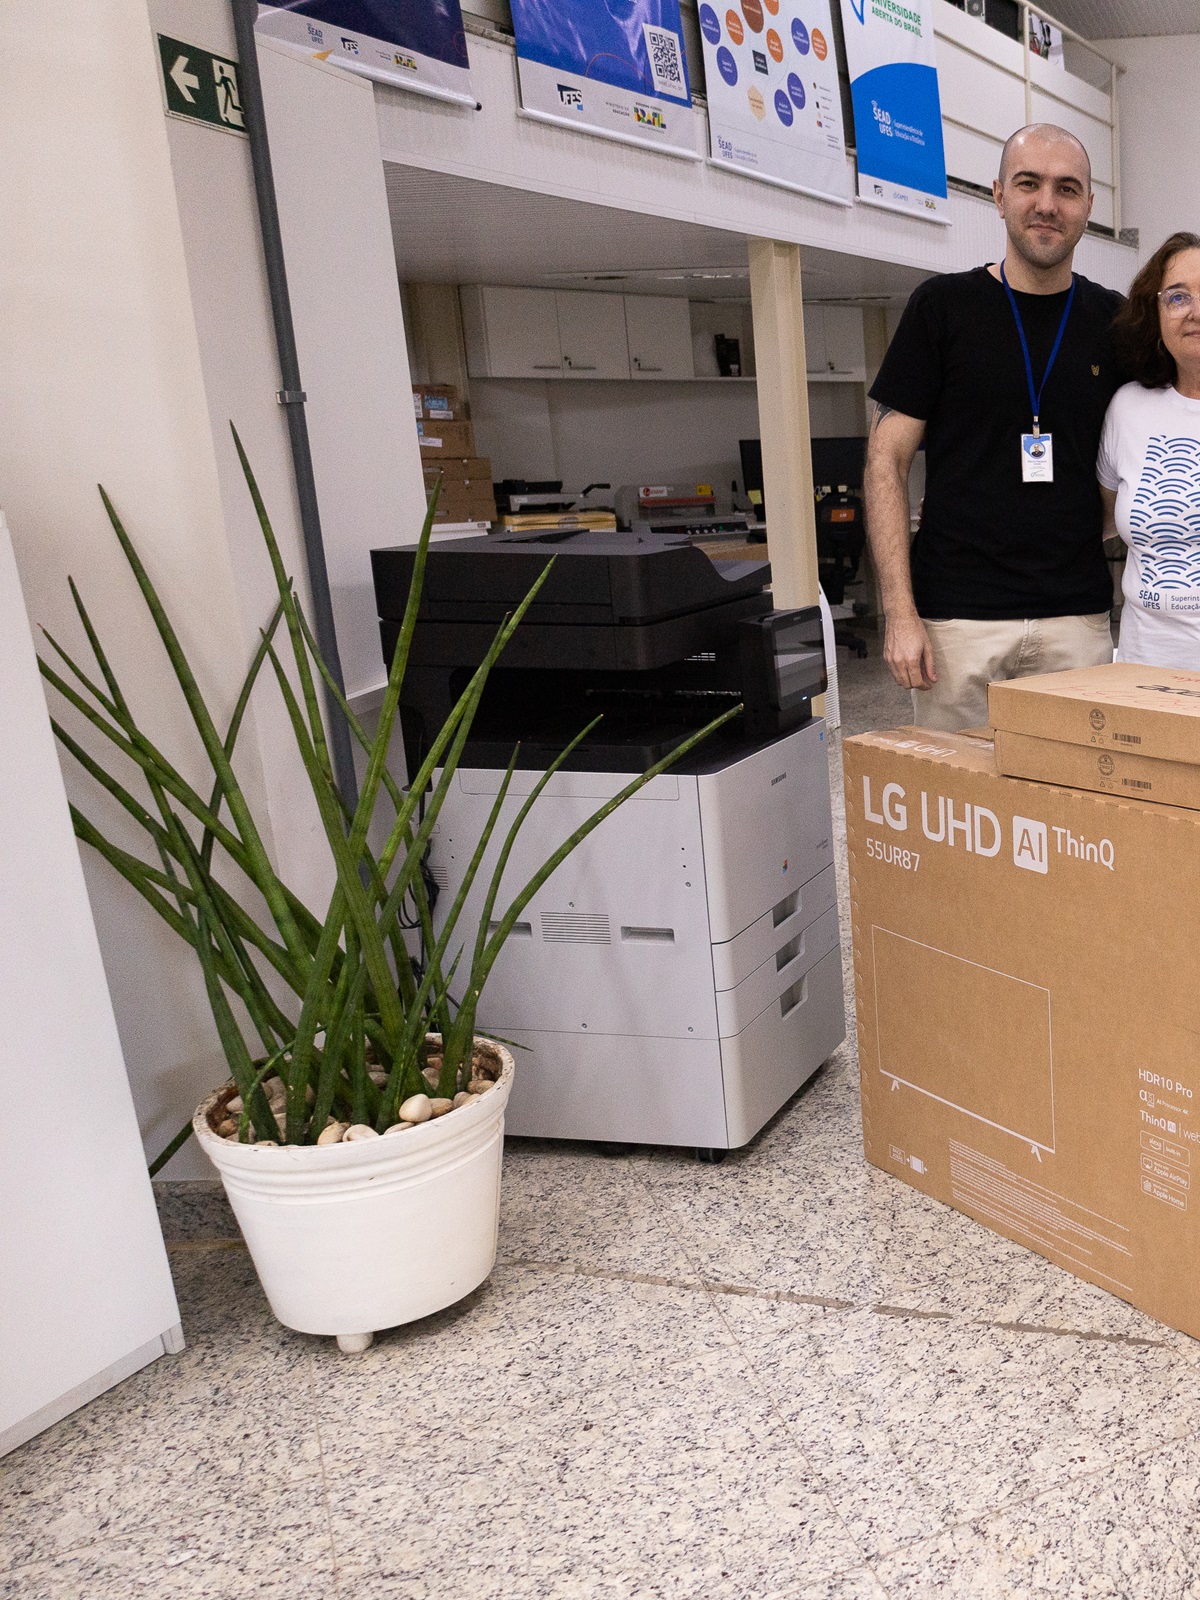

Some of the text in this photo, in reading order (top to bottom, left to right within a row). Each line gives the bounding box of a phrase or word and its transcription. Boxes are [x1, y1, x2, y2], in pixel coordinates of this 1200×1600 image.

[872, 7, 922, 38] ABERTA DO BRASIL
[872, 107, 892, 125] SEAD
[879, 122, 893, 137] UFES
[718, 138, 733, 152] SEAD
[722, 150, 733, 159] UFES
[1138, 589, 1160, 602] SEAD
[1143, 601, 1161, 610] UFES
[770, 772, 787, 786] SAMSUNG
[863, 775, 1115, 871] LG UHD AI ThinQ
[866, 837, 920, 872] 55UR87
[1138, 1067, 1193, 1098] HDR10 Pro
[1139, 1109, 1167, 1131] ThinQ
[1153, 1166, 1188, 1187] Apple AirPlay
[1152, 1188, 1185, 1207] Apple Home
